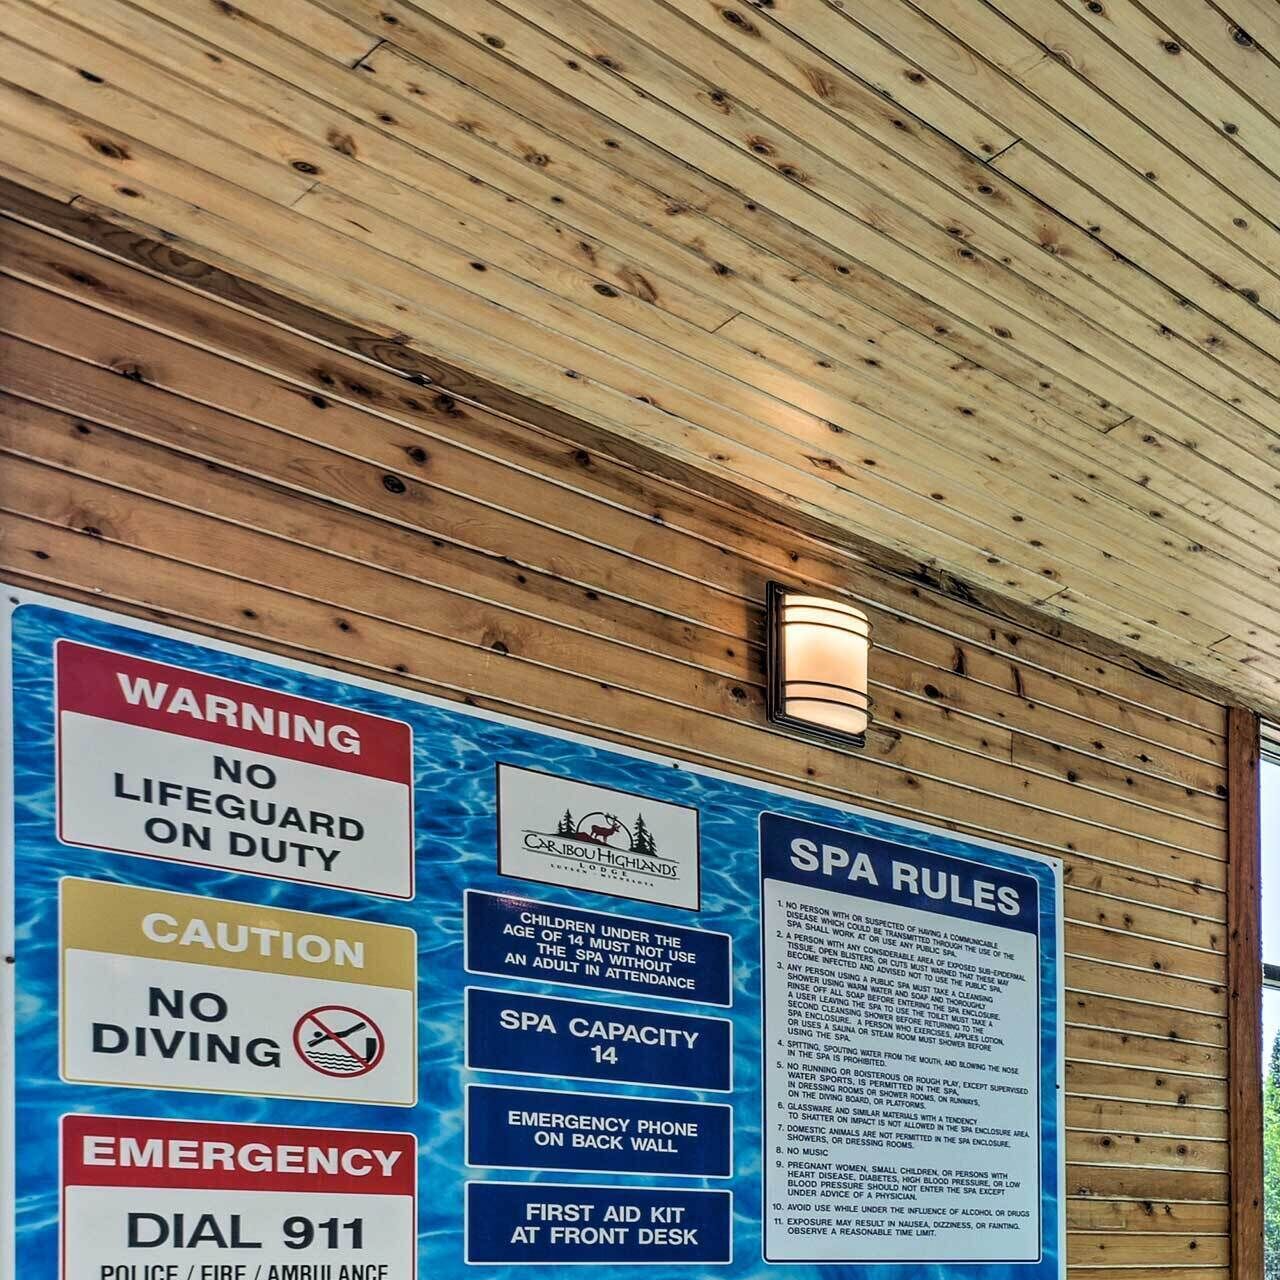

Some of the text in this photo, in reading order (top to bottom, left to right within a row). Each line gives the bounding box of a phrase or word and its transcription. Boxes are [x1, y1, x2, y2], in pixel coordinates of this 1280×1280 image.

[116, 672, 360, 755] WARNING
[213, 755, 276, 790] NO
[114, 772, 364, 842] LIFEGUARD
[144, 817, 341, 871] ON DUTY
[524, 834, 677, 877] CARIBOU HIGHLANDS
[580, 862, 628, 877] LODGE
[790, 838, 1020, 916] SPA RULES
[141, 913, 364, 969] CAUTION
[503, 923, 696, 962] AGE OF 14 MUST NOT USE
[520, 912, 681, 947] CHILDREN UNDER THE
[786, 919, 802, 931] SPA
[805, 923, 830, 935] SHALL
[832, 928, 854, 939] WORK
[857, 932, 865, 941] AT
[868, 934, 880, 945] OR
[882, 937, 896, 947] USE
[899, 940, 913, 950] ANY
[915, 943, 940, 955] PUBLIC
[504, 952, 695, 989] AN ADULT IN ATTENDANCE
[536, 942, 672, 972] THE SPA WITHOUT
[149, 987, 228, 1023] NO
[92, 1022, 280, 1068] DIVING
[499, 1009, 699, 1048] SPA CAPACITY
[590, 1045, 618, 1064] 14
[786, 1062, 799, 1071] NO
[802, 1064, 837, 1075] RUNNING
[839, 1068, 851, 1077] OR
[853, 1069, 900, 1082] BOISTEROUS
[903, 1075, 913, 1083] OR
[915, 1076, 940, 1086] ROUGH
[962, 1081, 987, 1091] EXCEPT
[990, 1084, 1028, 1095] SUPERVISED
[787, 1071, 816, 1082] WATER
[858, 1078, 866, 1086] IS
[869, 1080, 913, 1092] PERMITTED
[915, 1084, 923, 1093] IN
[926, 1085, 940, 1094] THE
[508, 1110, 698, 1136] EMERGENCY PHONE
[83, 1135, 402, 1177] EMERGENCY
[534, 1131, 678, 1152] ON BACK WALL
[786, 1147, 799, 1155] NO
[802, 1148, 828, 1158] MUSIC
[787, 1161, 831, 1172] PREGNANT
[871, 1166, 897, 1174] SMALL
[941, 1169, 952, 1177] OR
[955, 1170, 988, 1179] PERSONS
[991, 1172, 1008, 1180] WITH
[787, 1171, 814, 1181] HEART
[902, 1176, 920, 1184] HIGH
[923, 1177, 949, 1185] BLOOD
[992, 1180, 1003, 1188] OR
[787, 1180, 1005, 1196] BLOOD PRESSURE SHOULD NOT ENTER THE SPA EXCEPT
[787, 1189, 817, 1197] UNDER
[820, 1190, 850, 1198] ADVICE
[852, 1191, 863, 1199] OF
[526, 1203, 685, 1222] FIRST AID KIT
[786, 1218, 832, 1226] EXPOSURE
[835, 1219, 851, 1228] MAY
[855, 1220, 884, 1228] RESULT
[887, 1220, 895, 1228] IN
[787, 1204, 811, 1213] AVOID
[814, 1204, 831, 1212] USE
[834, 1205, 858, 1213] WHILE
[861, 1206, 887, 1214] UNDER
[907, 1207, 946, 1215] INFLUENCE
[949, 1208, 959, 1216] OF
[961, 1209, 992, 1217] ALCOHOL
[995, 1209, 1005, 1217] OR
[127, 1212, 362, 1249] DIAL 911
[510, 1226, 698, 1244] AT FRONT DESK
[787, 1227, 827, 1235] OBSERVE
[839, 1228, 892, 1236] REASONABLE
